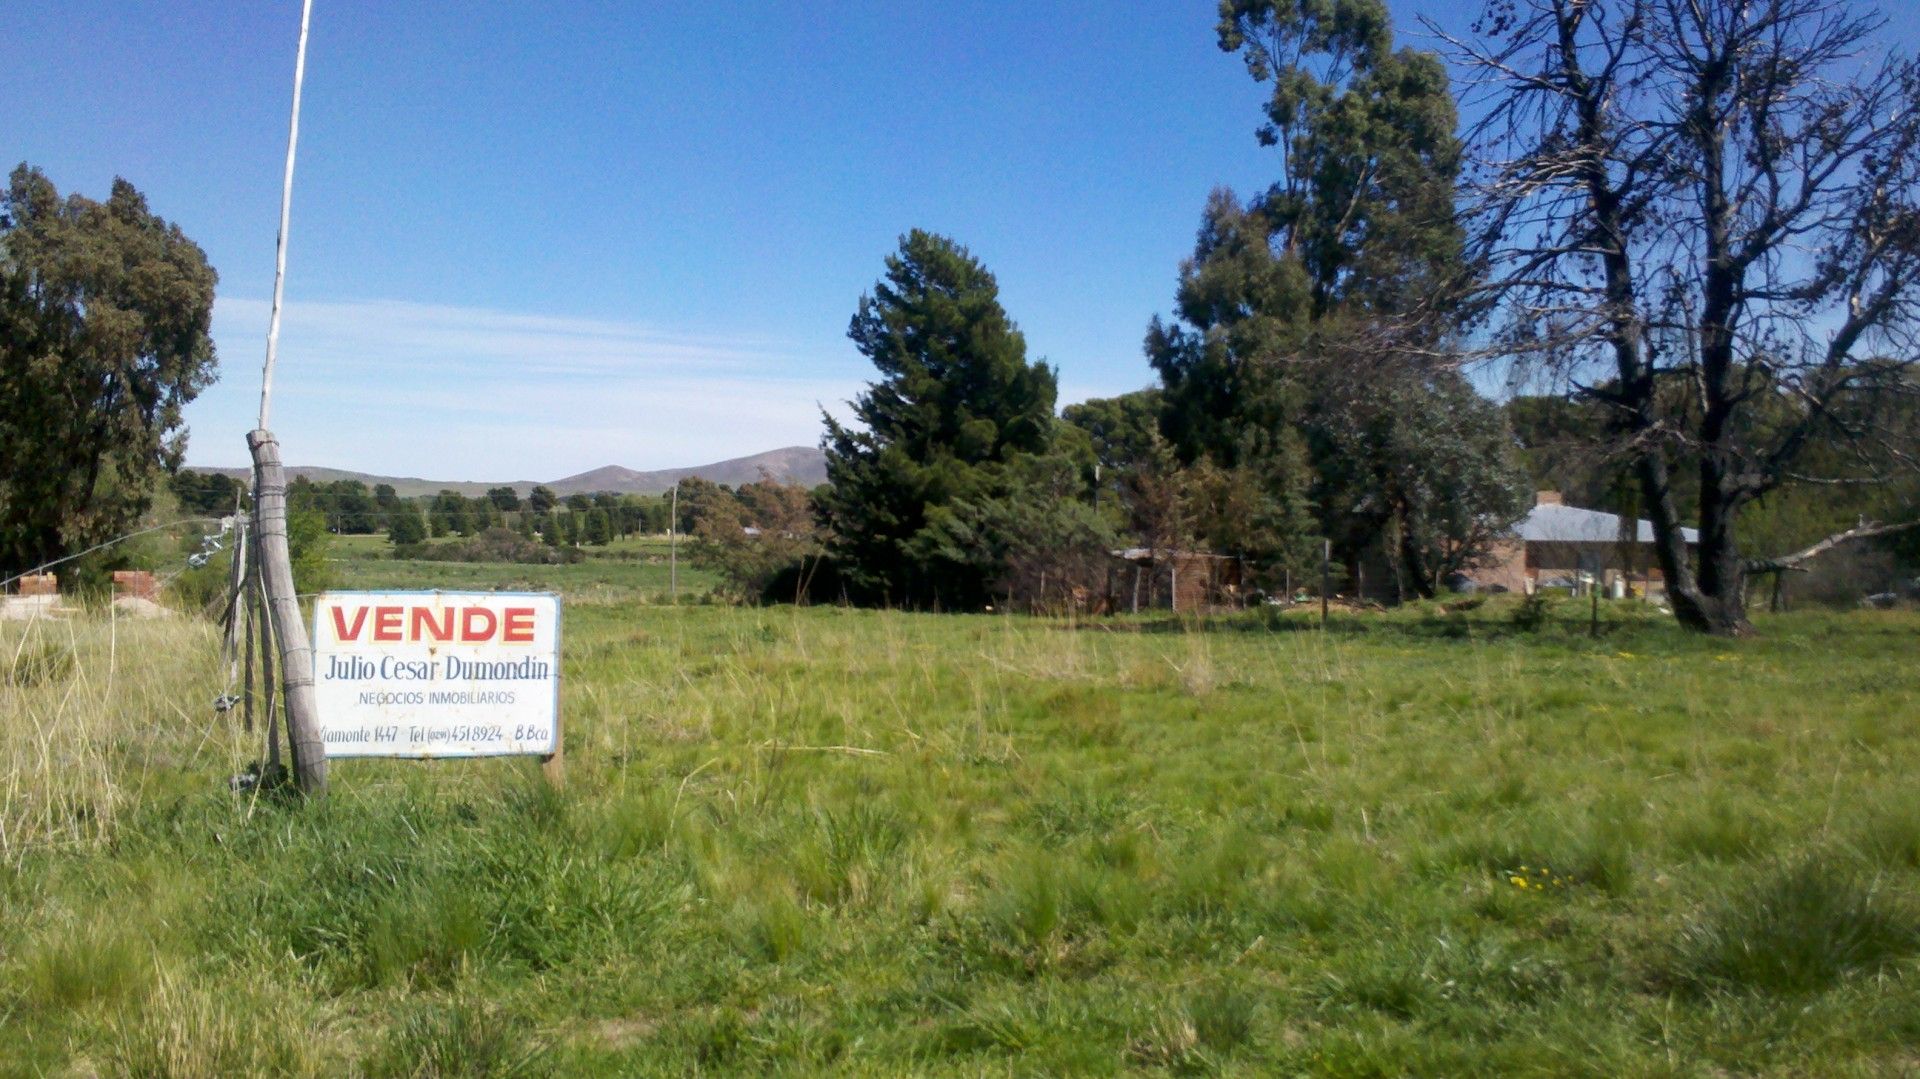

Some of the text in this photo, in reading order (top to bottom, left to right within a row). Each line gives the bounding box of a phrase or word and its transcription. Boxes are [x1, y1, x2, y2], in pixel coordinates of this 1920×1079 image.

[330, 606, 535, 643] VENDE
[325, 655, 549, 681] Julio Cesar Dumondin
[359, 691, 516, 705] NEGOCIOS INMOBILIARIOS
[374, 726, 398, 743] 1447
[409, 725, 425, 742] Tel
